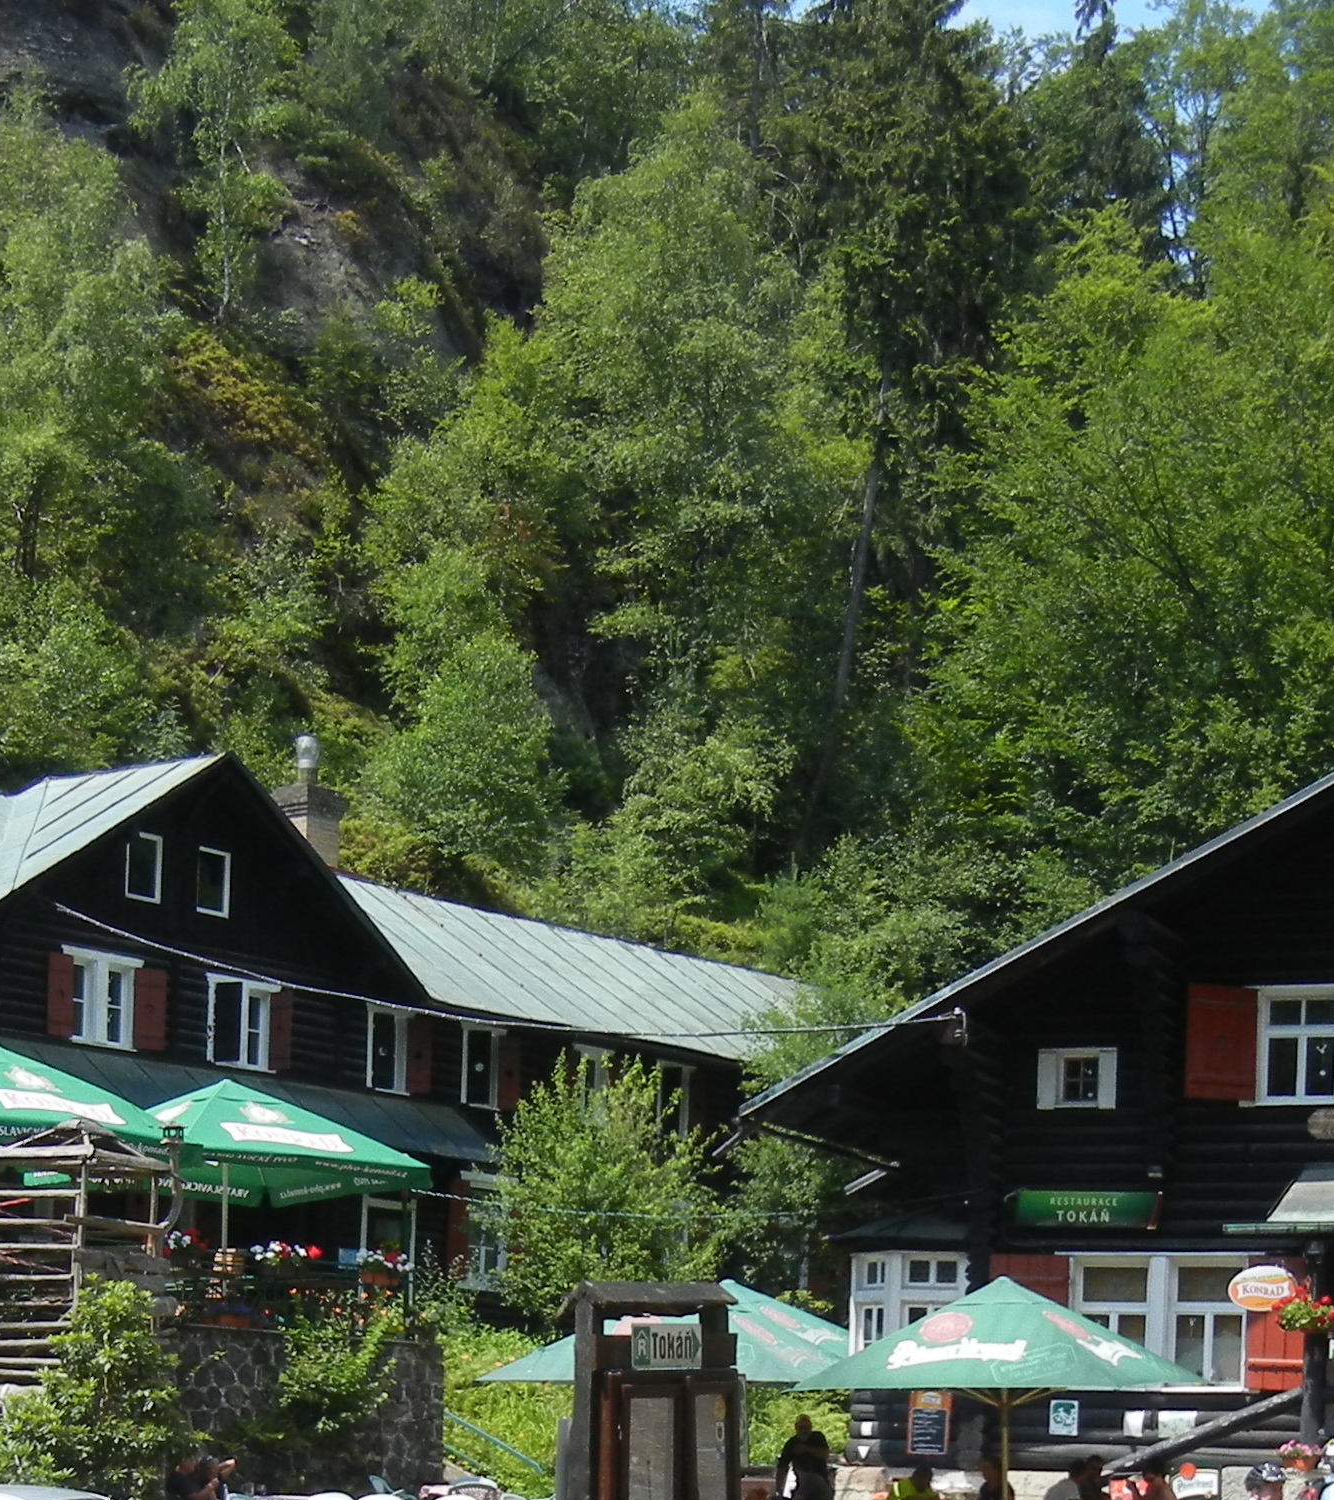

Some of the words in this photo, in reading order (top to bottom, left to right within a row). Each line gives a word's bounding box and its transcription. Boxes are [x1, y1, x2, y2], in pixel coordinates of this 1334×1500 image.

[1050, 1197, 1118, 1207] RESTAURACE
[1056, 1209, 1111, 1223] TOKÁŇ
[1242, 1283, 1285, 1297] KONRAD
[652, 1331, 692, 1360] Tokáň
